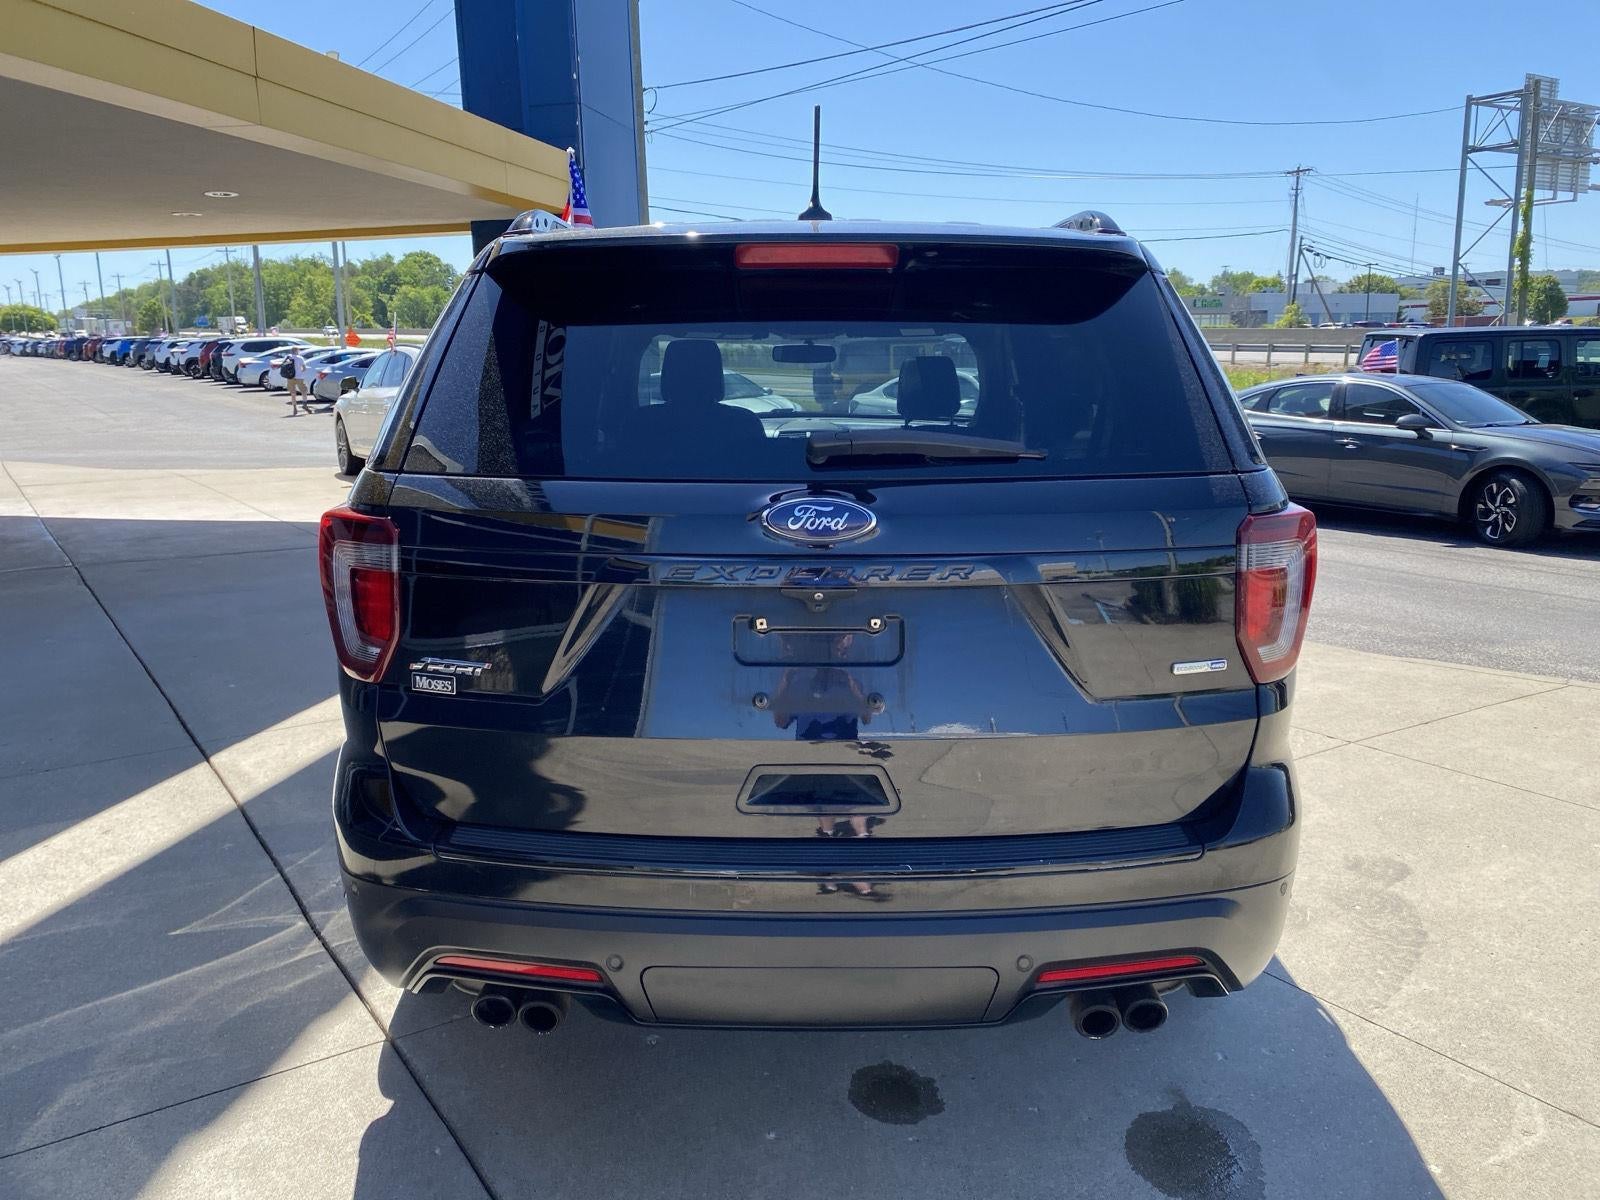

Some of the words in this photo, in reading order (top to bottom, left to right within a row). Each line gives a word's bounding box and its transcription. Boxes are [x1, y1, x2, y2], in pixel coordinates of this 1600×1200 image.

[787, 504, 848, 531] Ford
[663, 564, 976, 581] EXPLORER
[415, 676, 452, 691] MOSES
